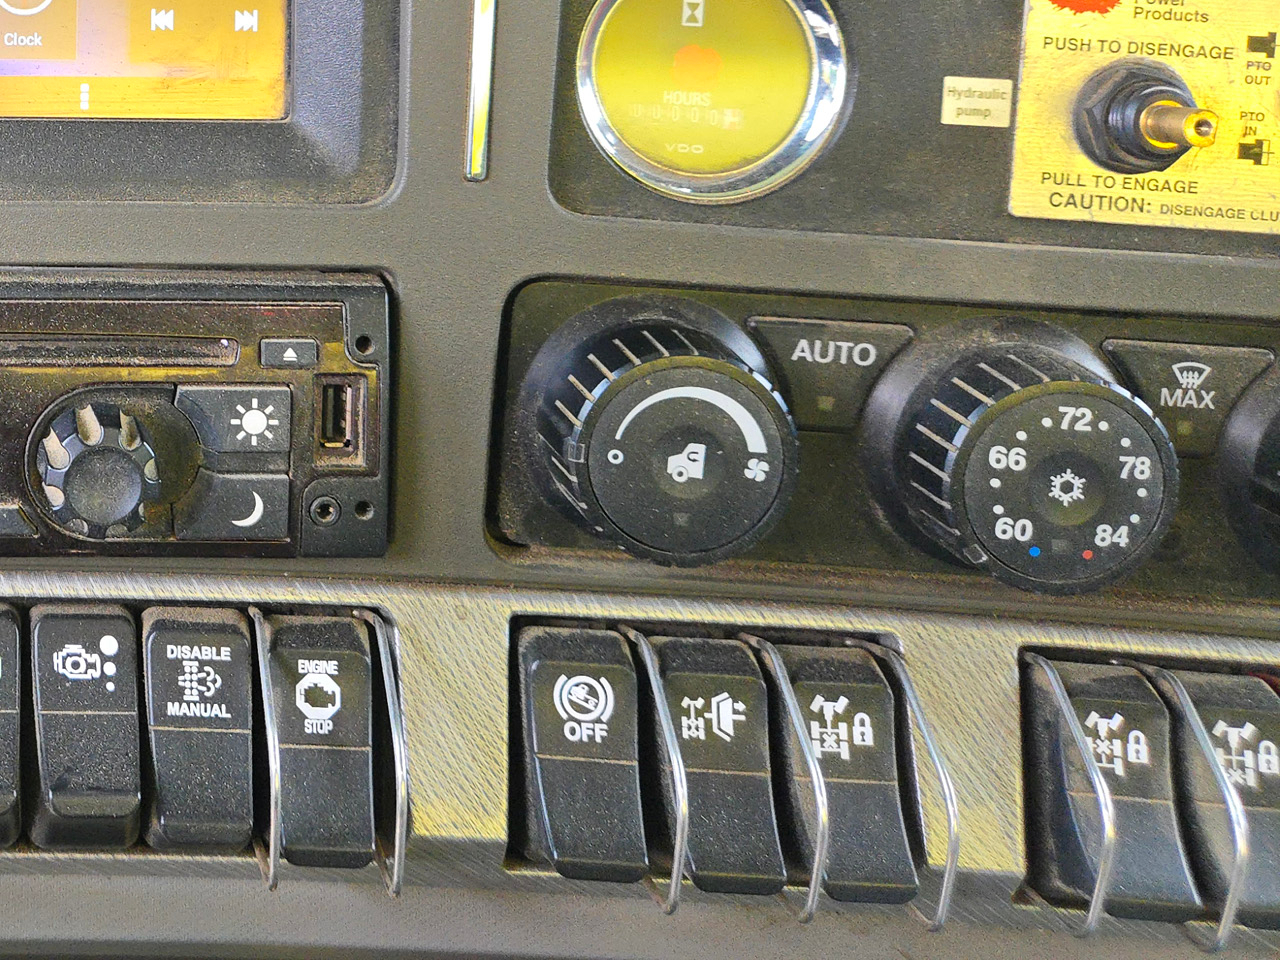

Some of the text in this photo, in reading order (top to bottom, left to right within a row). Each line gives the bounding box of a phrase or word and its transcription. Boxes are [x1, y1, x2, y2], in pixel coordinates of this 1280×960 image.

[1133, 6, 1210, 23] Products
[3, 32, 43, 46] Clock
[1043, 36, 1234, 60] PUSH TO DISENGAGE
[1246, 60, 1272, 71] PTO
[1244, 75, 1272, 86] OUT
[663, 90, 711, 107] HOURS
[947, 86, 1008, 101] Hydraulic
[955, 107, 992, 120] pump
[1240, 111, 1265, 122] PTO
[1244, 126, 1257, 137] IN
[665, 143, 705, 154] VDO
[1041, 172, 1199, 194] PULL TO ENGAGE
[1049, 192, 1152, 213] CAUTION:
[1160, 203, 1246, 220] DISENGAGE
[791, 339, 876, 366] AUTO
[1160, 387, 1216, 410] MAX
[1058, 406, 1093, 431] 72
[988, 446, 1027, 471] 66
[1119, 456, 1151, 480] 78
[994, 517, 1033, 541] 60
[1094, 524, 1129, 547] 84
[166, 644, 231, 661] DISABLE
[297, 660, 339, 675] ENGINE
[166, 702, 232, 719] MANUAL
[303, 719, 334, 735] STOP
[564, 721, 609, 743] OFF
